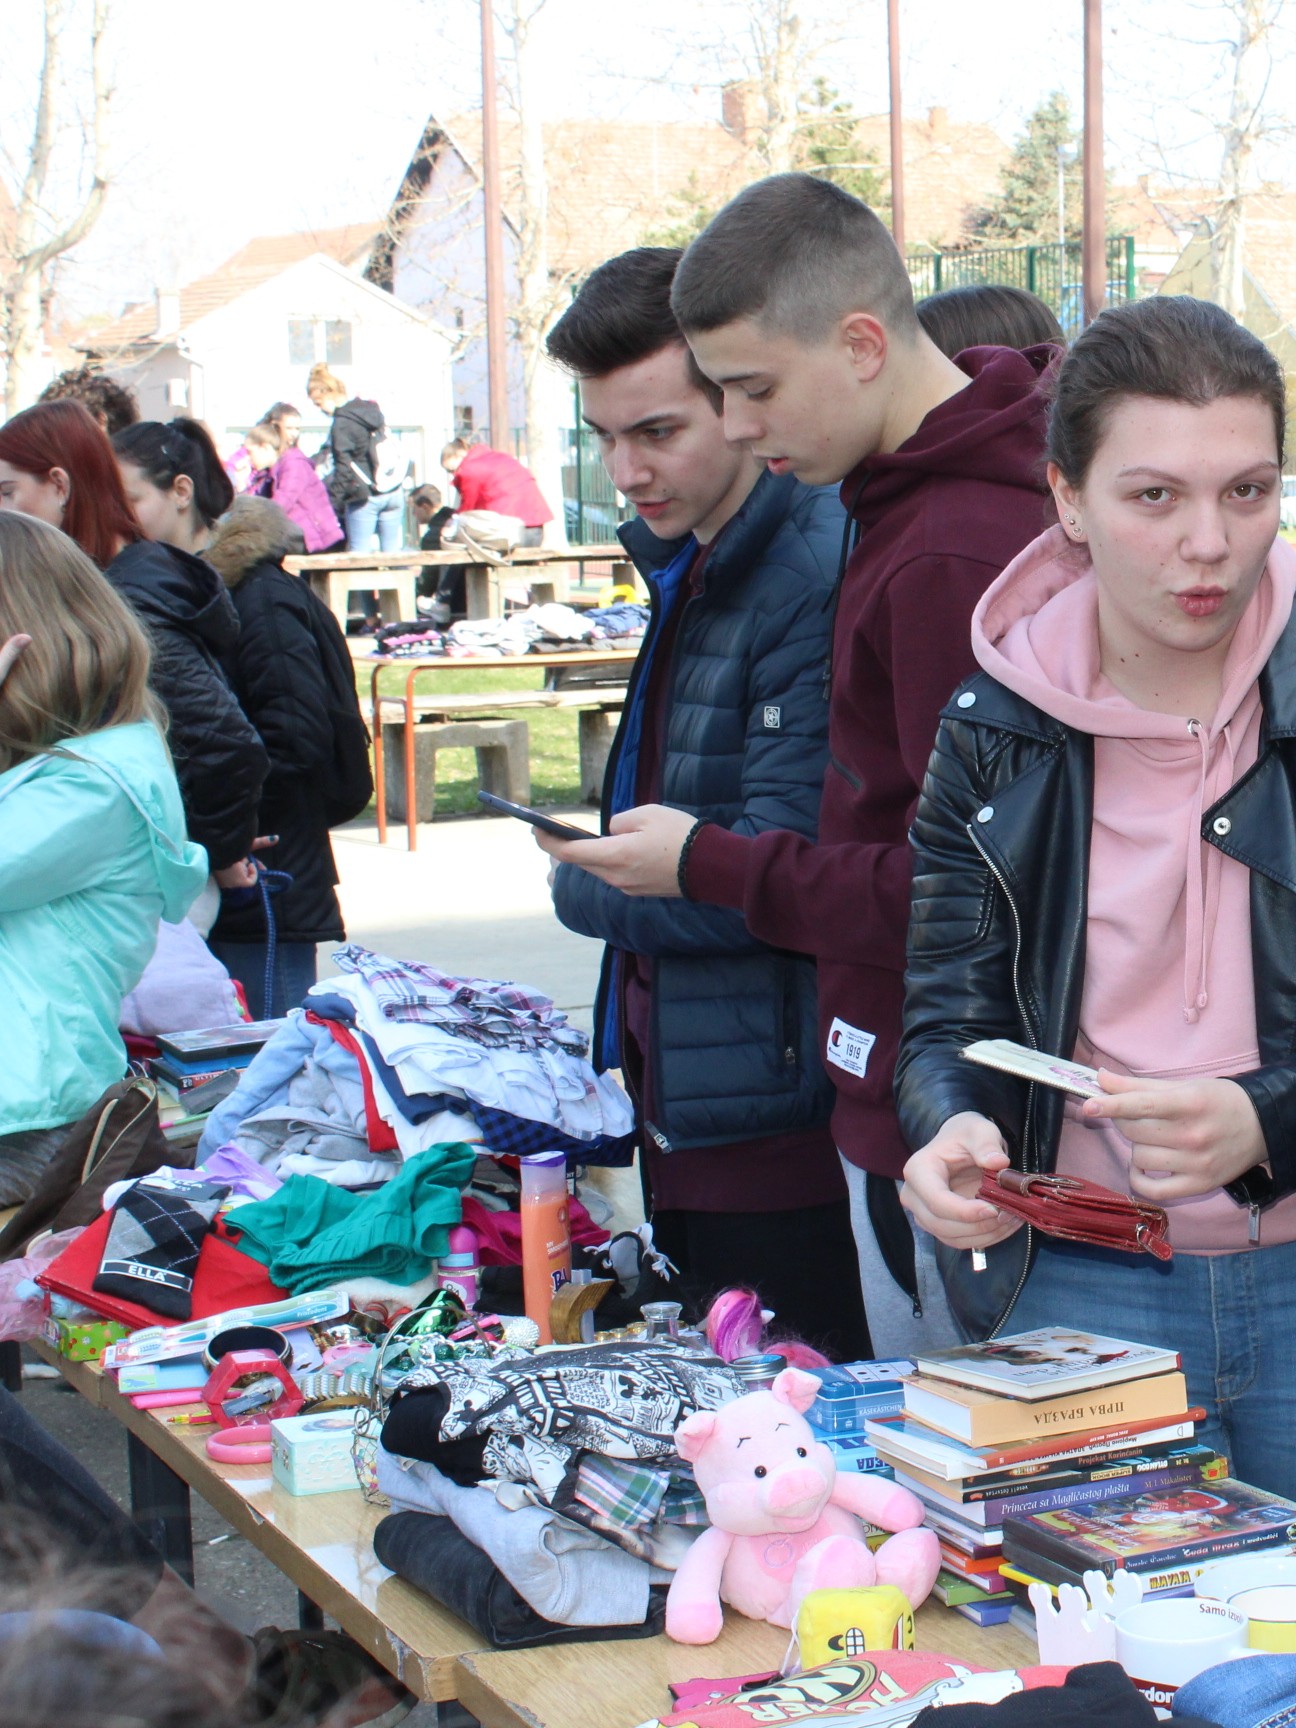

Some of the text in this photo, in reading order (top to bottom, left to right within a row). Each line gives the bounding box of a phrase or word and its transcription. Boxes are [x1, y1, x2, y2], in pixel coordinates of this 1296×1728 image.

[846, 1043, 862, 1059] 1919
[127, 1265, 166, 1282] ELLA
[1034, 1401, 1124, 1425] ПРВА БРАЗДА
[1078, 1448, 1143, 1465] Projekat Korinčanin
[1001, 1499, 1037, 1515] Princeza
[1039, 1498, 1050, 1507] sa
[1051, 1487, 1102, 1505] Magličastog
[1103, 1482, 1130, 1501] plašta
[1161, 1474, 1192, 1486] Makalister
[1200, 1603, 1226, 1617] Samo
